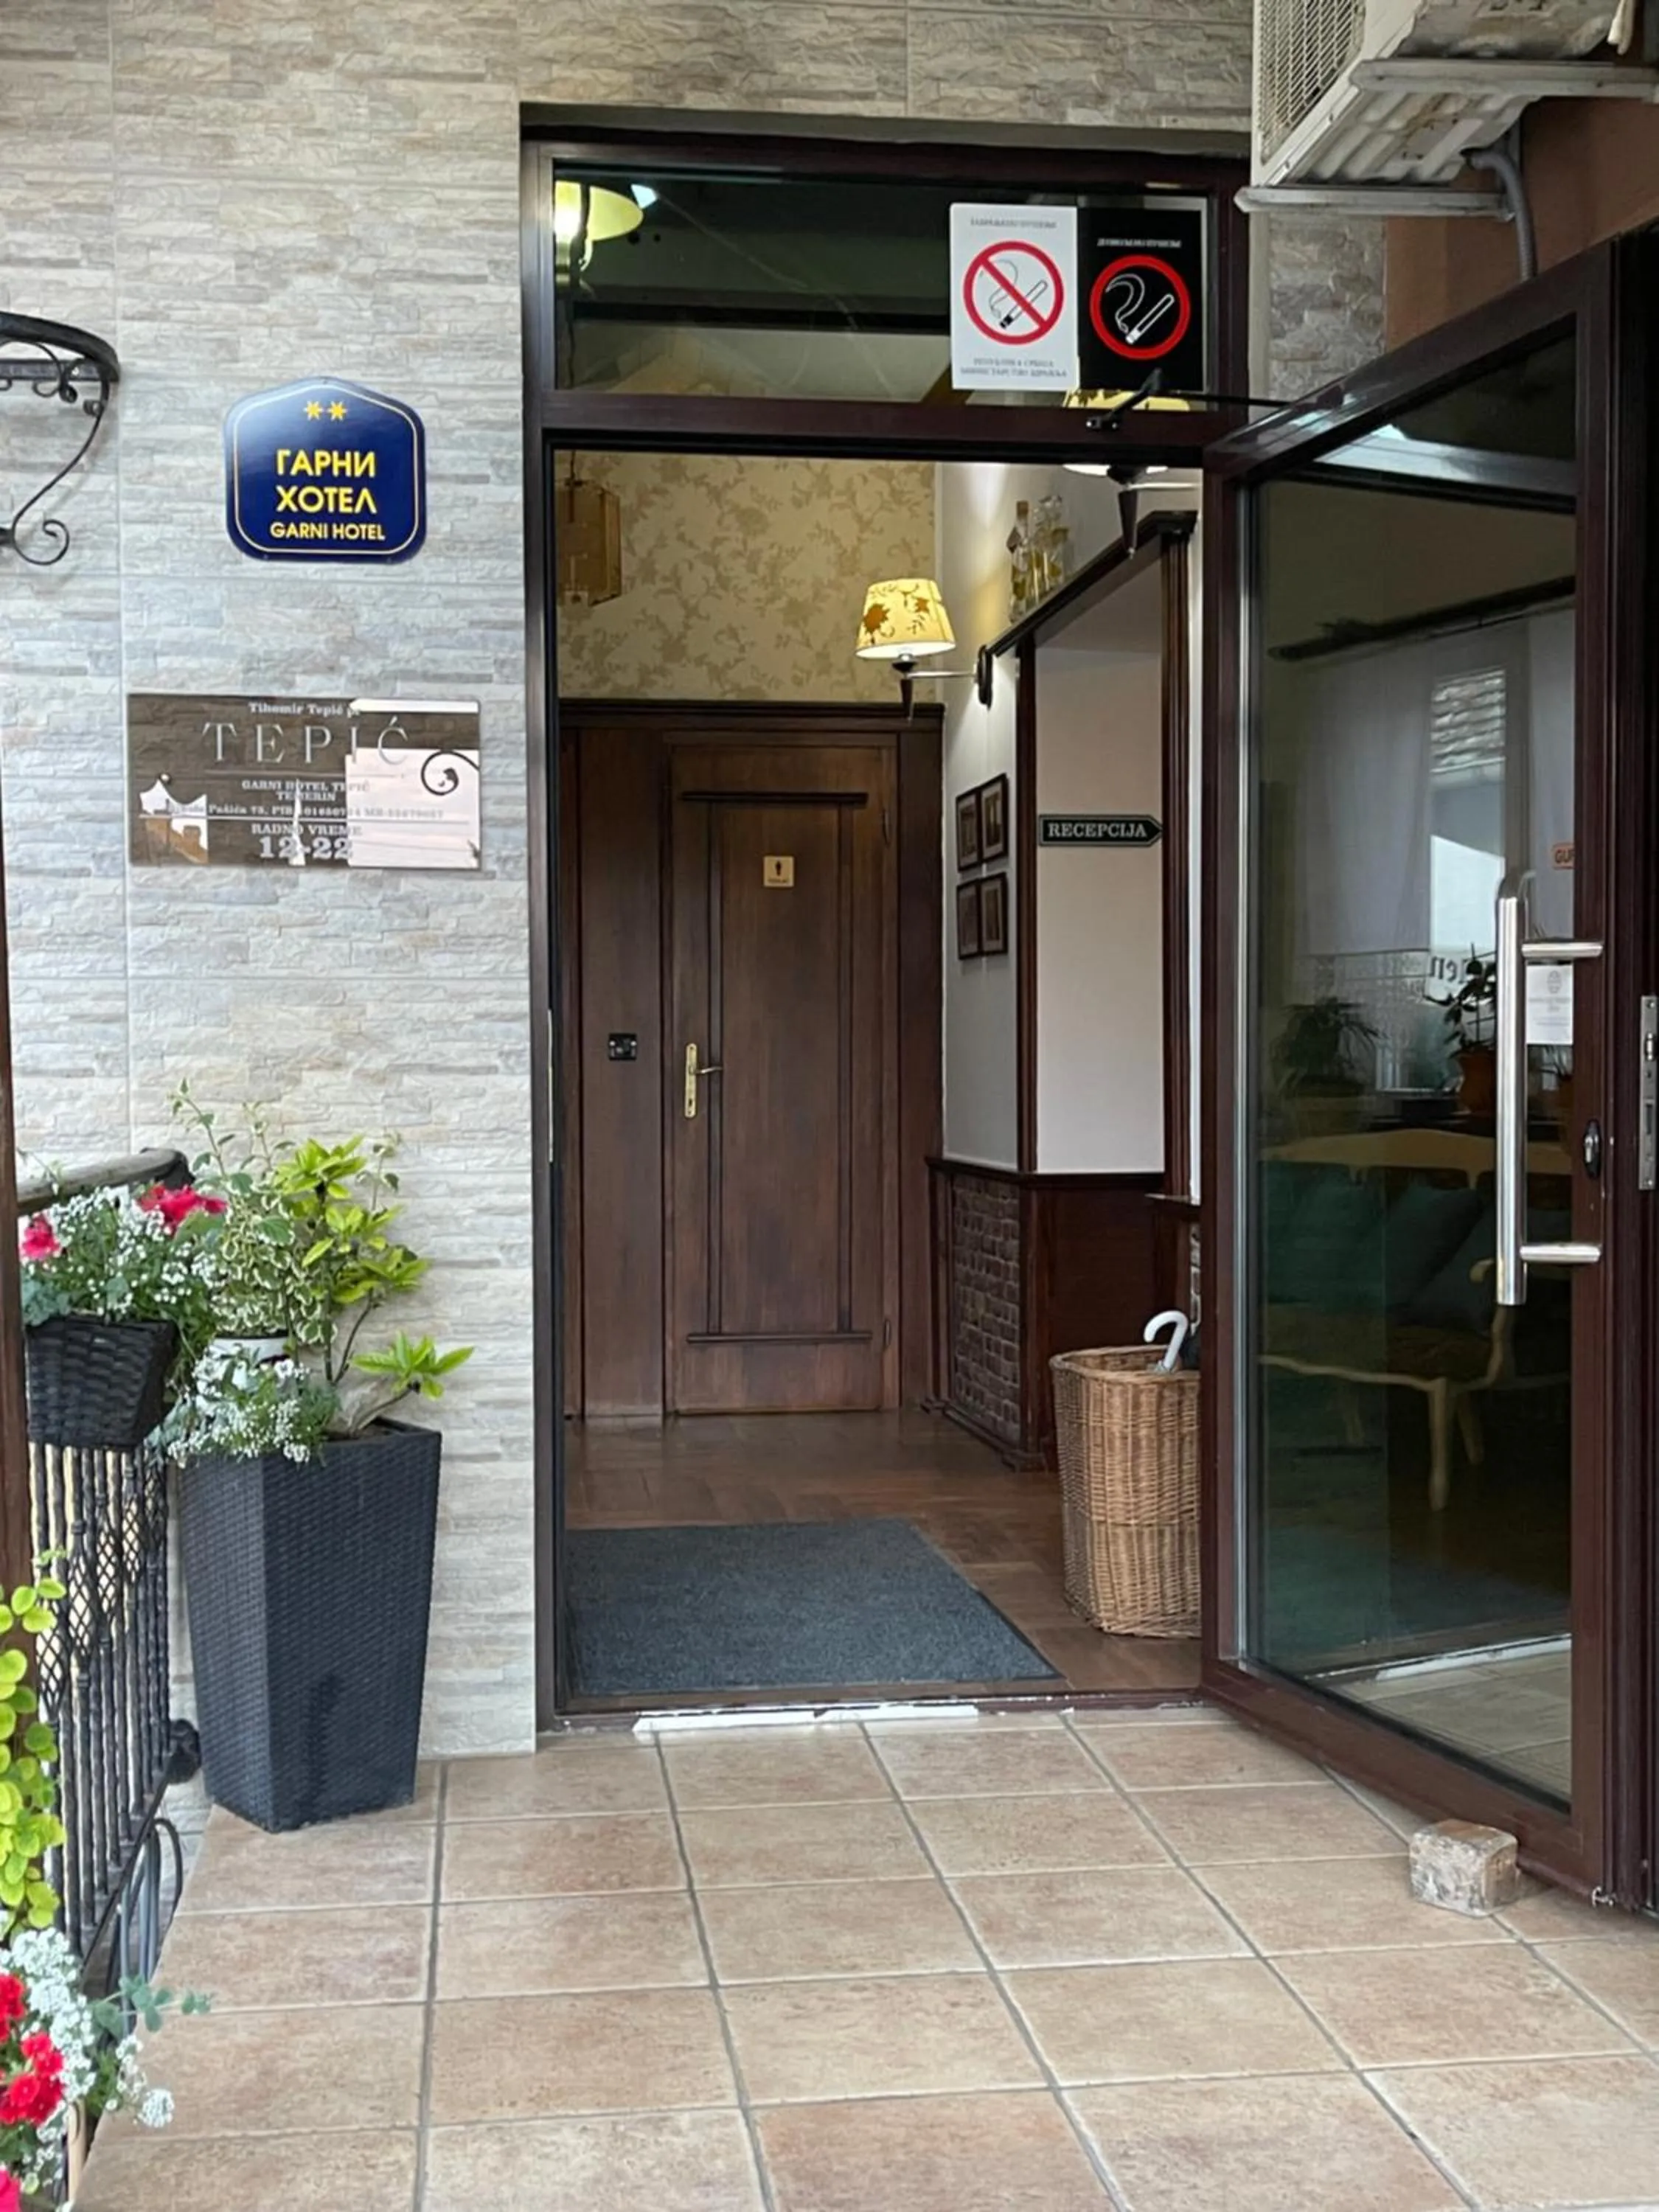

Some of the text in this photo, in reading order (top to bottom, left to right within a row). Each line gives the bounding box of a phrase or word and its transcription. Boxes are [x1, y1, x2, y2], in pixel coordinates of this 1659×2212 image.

[275, 448, 376, 478] ГАРНИ
[275, 484, 378, 514] ХОТЕЛ
[270, 521, 386, 540] GARNI HOTEL
[202, 715, 407, 765] TEPIĆ
[242, 779, 282, 790] GARNI
[1048, 822, 1147, 838] RECEPCIJA
